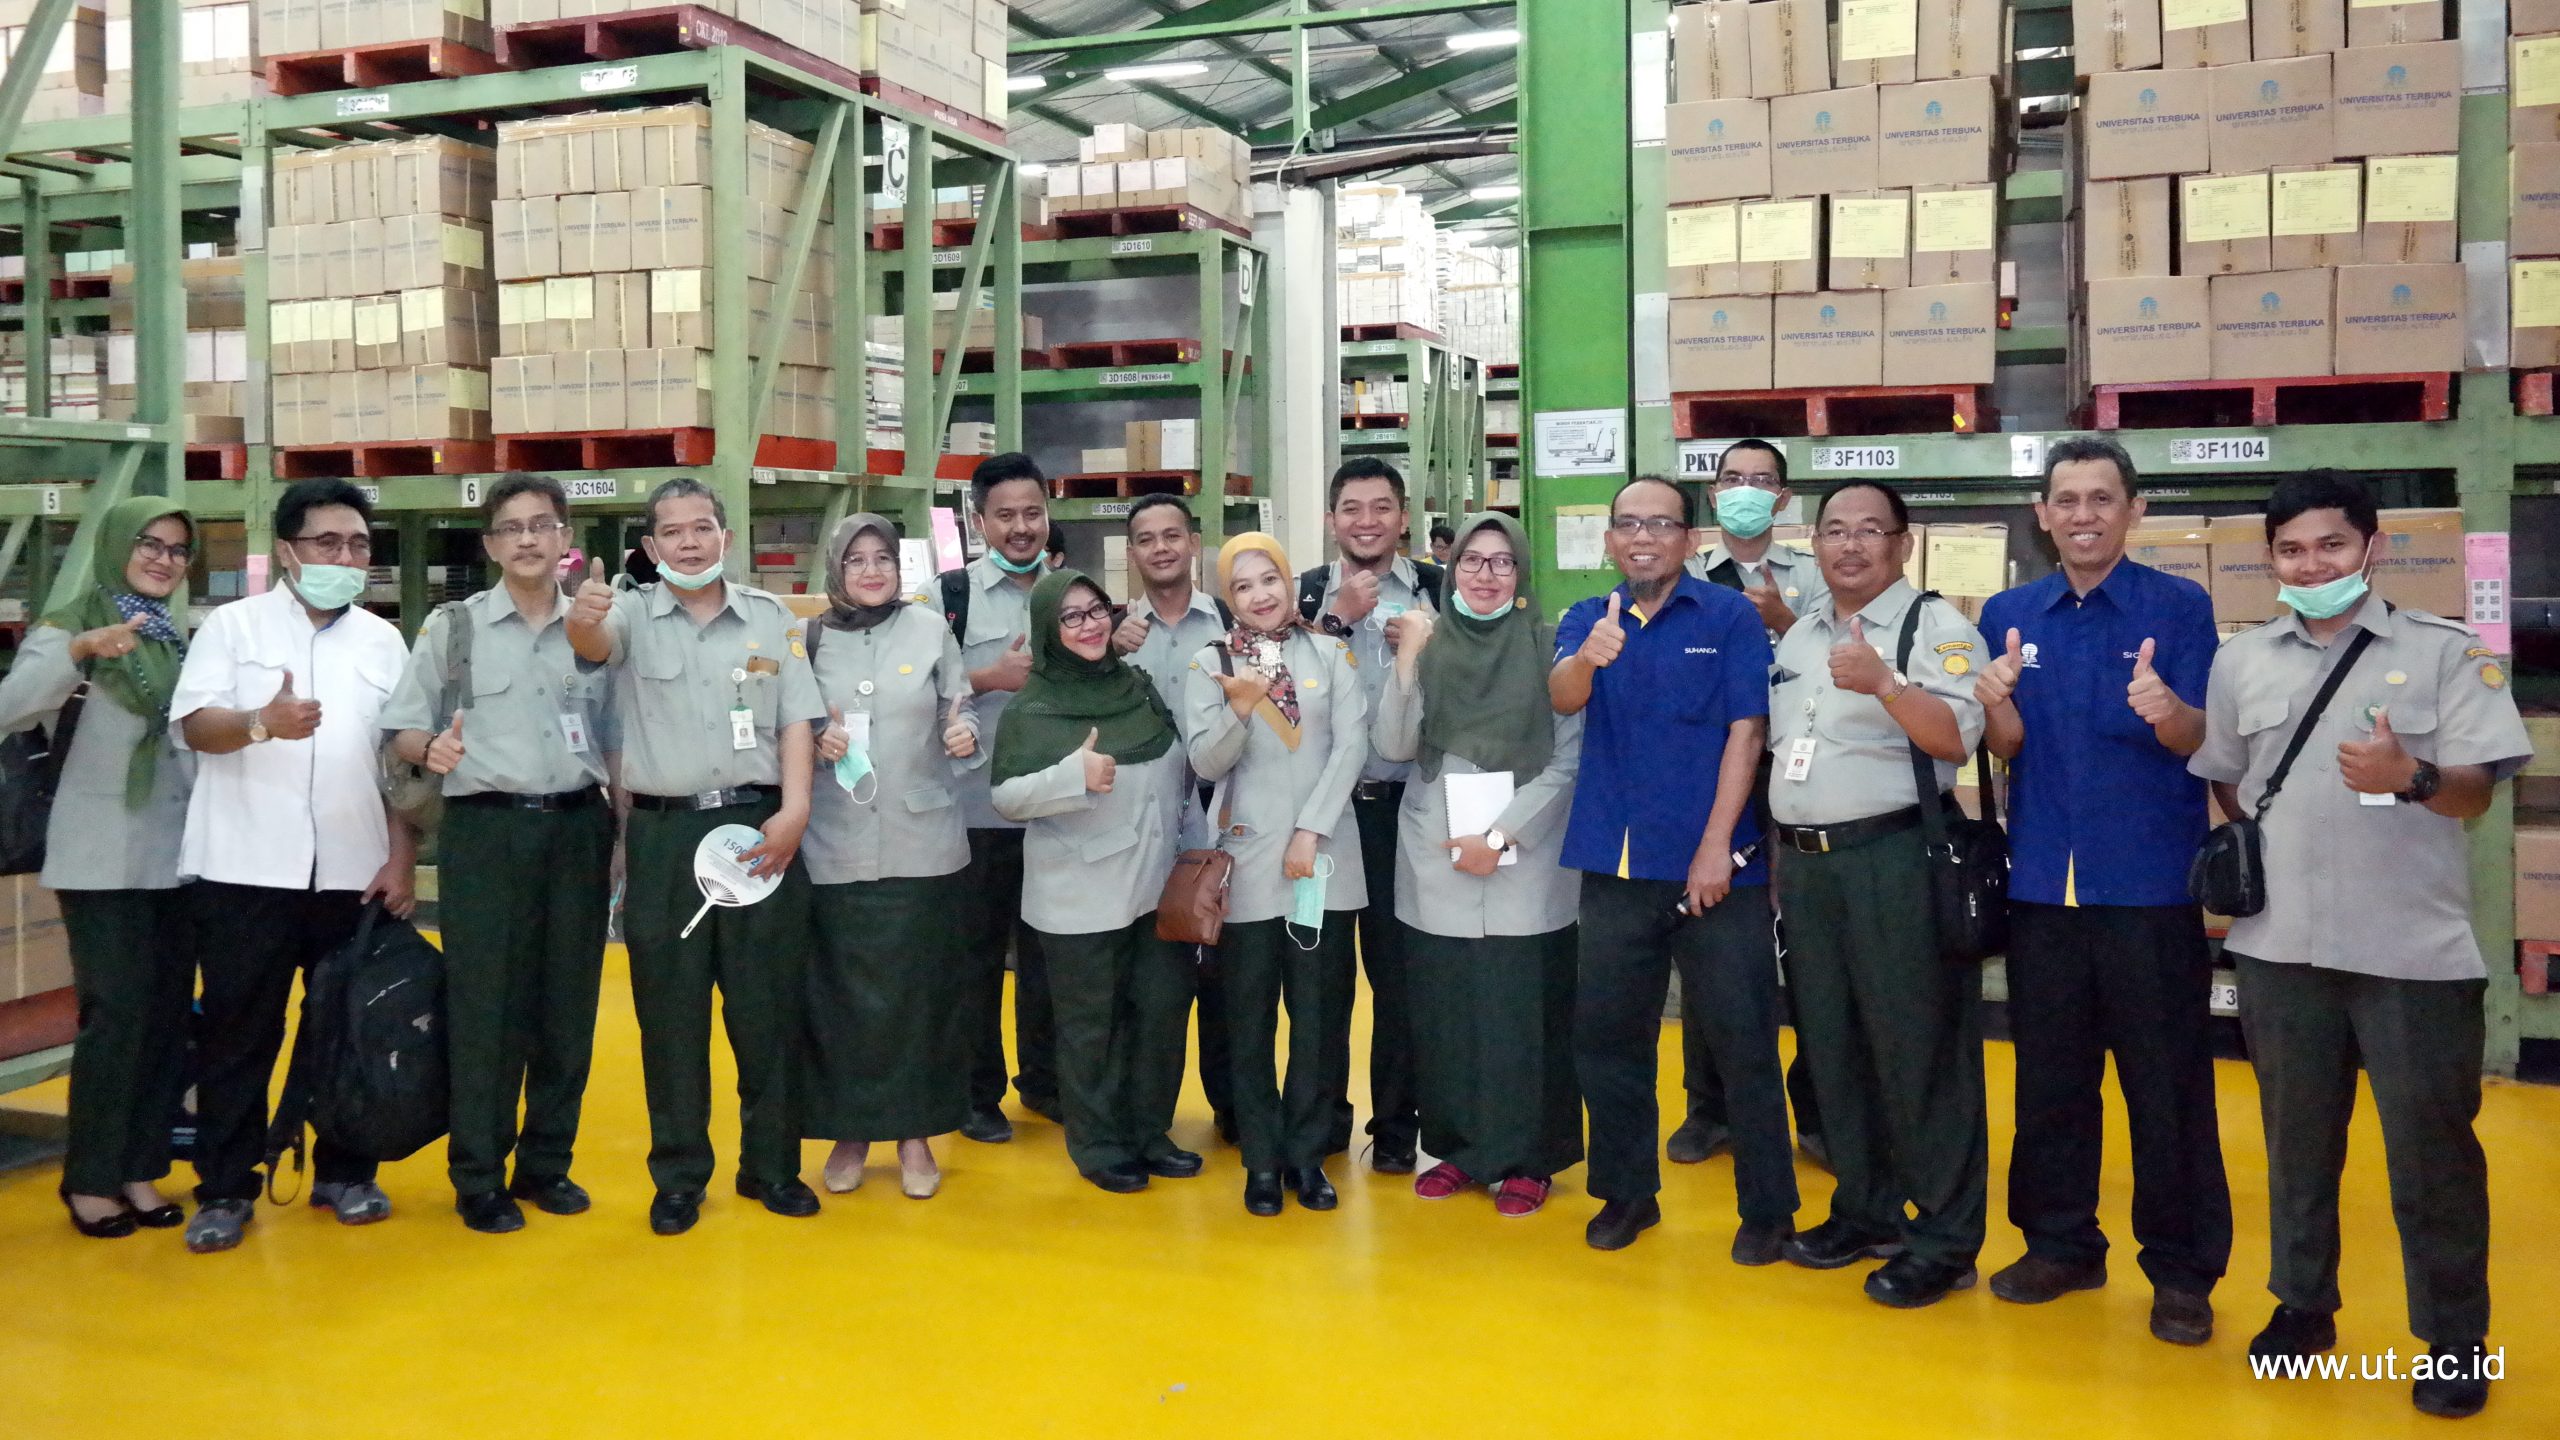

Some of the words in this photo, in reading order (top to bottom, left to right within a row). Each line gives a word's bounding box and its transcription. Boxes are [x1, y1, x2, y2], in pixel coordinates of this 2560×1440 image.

[2405, 90, 2453, 101] TERBUKA
[2215, 107, 2277, 122] UNIVERSITAS
[2279, 103, 2325, 115] TERBUKA
[2095, 116, 2154, 129] UNIVERSITAS
[2156, 112, 2201, 123] TERBUKA
[1884, 128, 1940, 140] UNIVERSITAS
[1941, 125, 1983, 136] TERBUKA
[1671, 144, 1723, 157] UNIVERSITAS
[1724, 140, 1763, 151] TERBUKA
[1776, 138, 1830, 150] UNIVERSITAS
[1832, 134, 1872, 145] TERBUKA
[887, 146, 906, 188] C
[1121, 239, 1151, 251] 3D1610
[933, 252, 960, 263] 3D1609
[1241, 263, 1251, 295] D
[2411, 311, 2457, 321] TERBUKA
[2096, 323, 2155, 336] UNIVERSITAS
[2157, 320, 2202, 331] TERBUKA
[2216, 320, 2278, 332] UNIVERSITAS
[2279, 318, 2325, 329] TERBUKA
[1674, 336, 1725, 345] UNIVERSITAS
[1726, 334, 1765, 343] TERBUKA
[1780, 331, 1834, 341] UNIVERSITAS
[1835, 329, 1875, 339] TERBUKA
[1889, 328, 1944, 338] UNIVERSITAS
[1945, 327, 1987, 336] TERBUKA
[1108, 373, 1137, 383] 3D1608
[2195, 440, 2265, 459] 3F1104
[1834, 450, 1895, 467] 3F1103
[467, 482, 476, 502] 6
[575, 481, 615, 496] 3C1604
[47, 491, 56, 510] 5
[1101, 504, 1131, 514] 3D1606
[2158, 562, 2201, 572] TERBUKA
[2219, 563, 2274, 573] UNIVERSITA
[2410, 556, 2456, 566] TERBUKA
